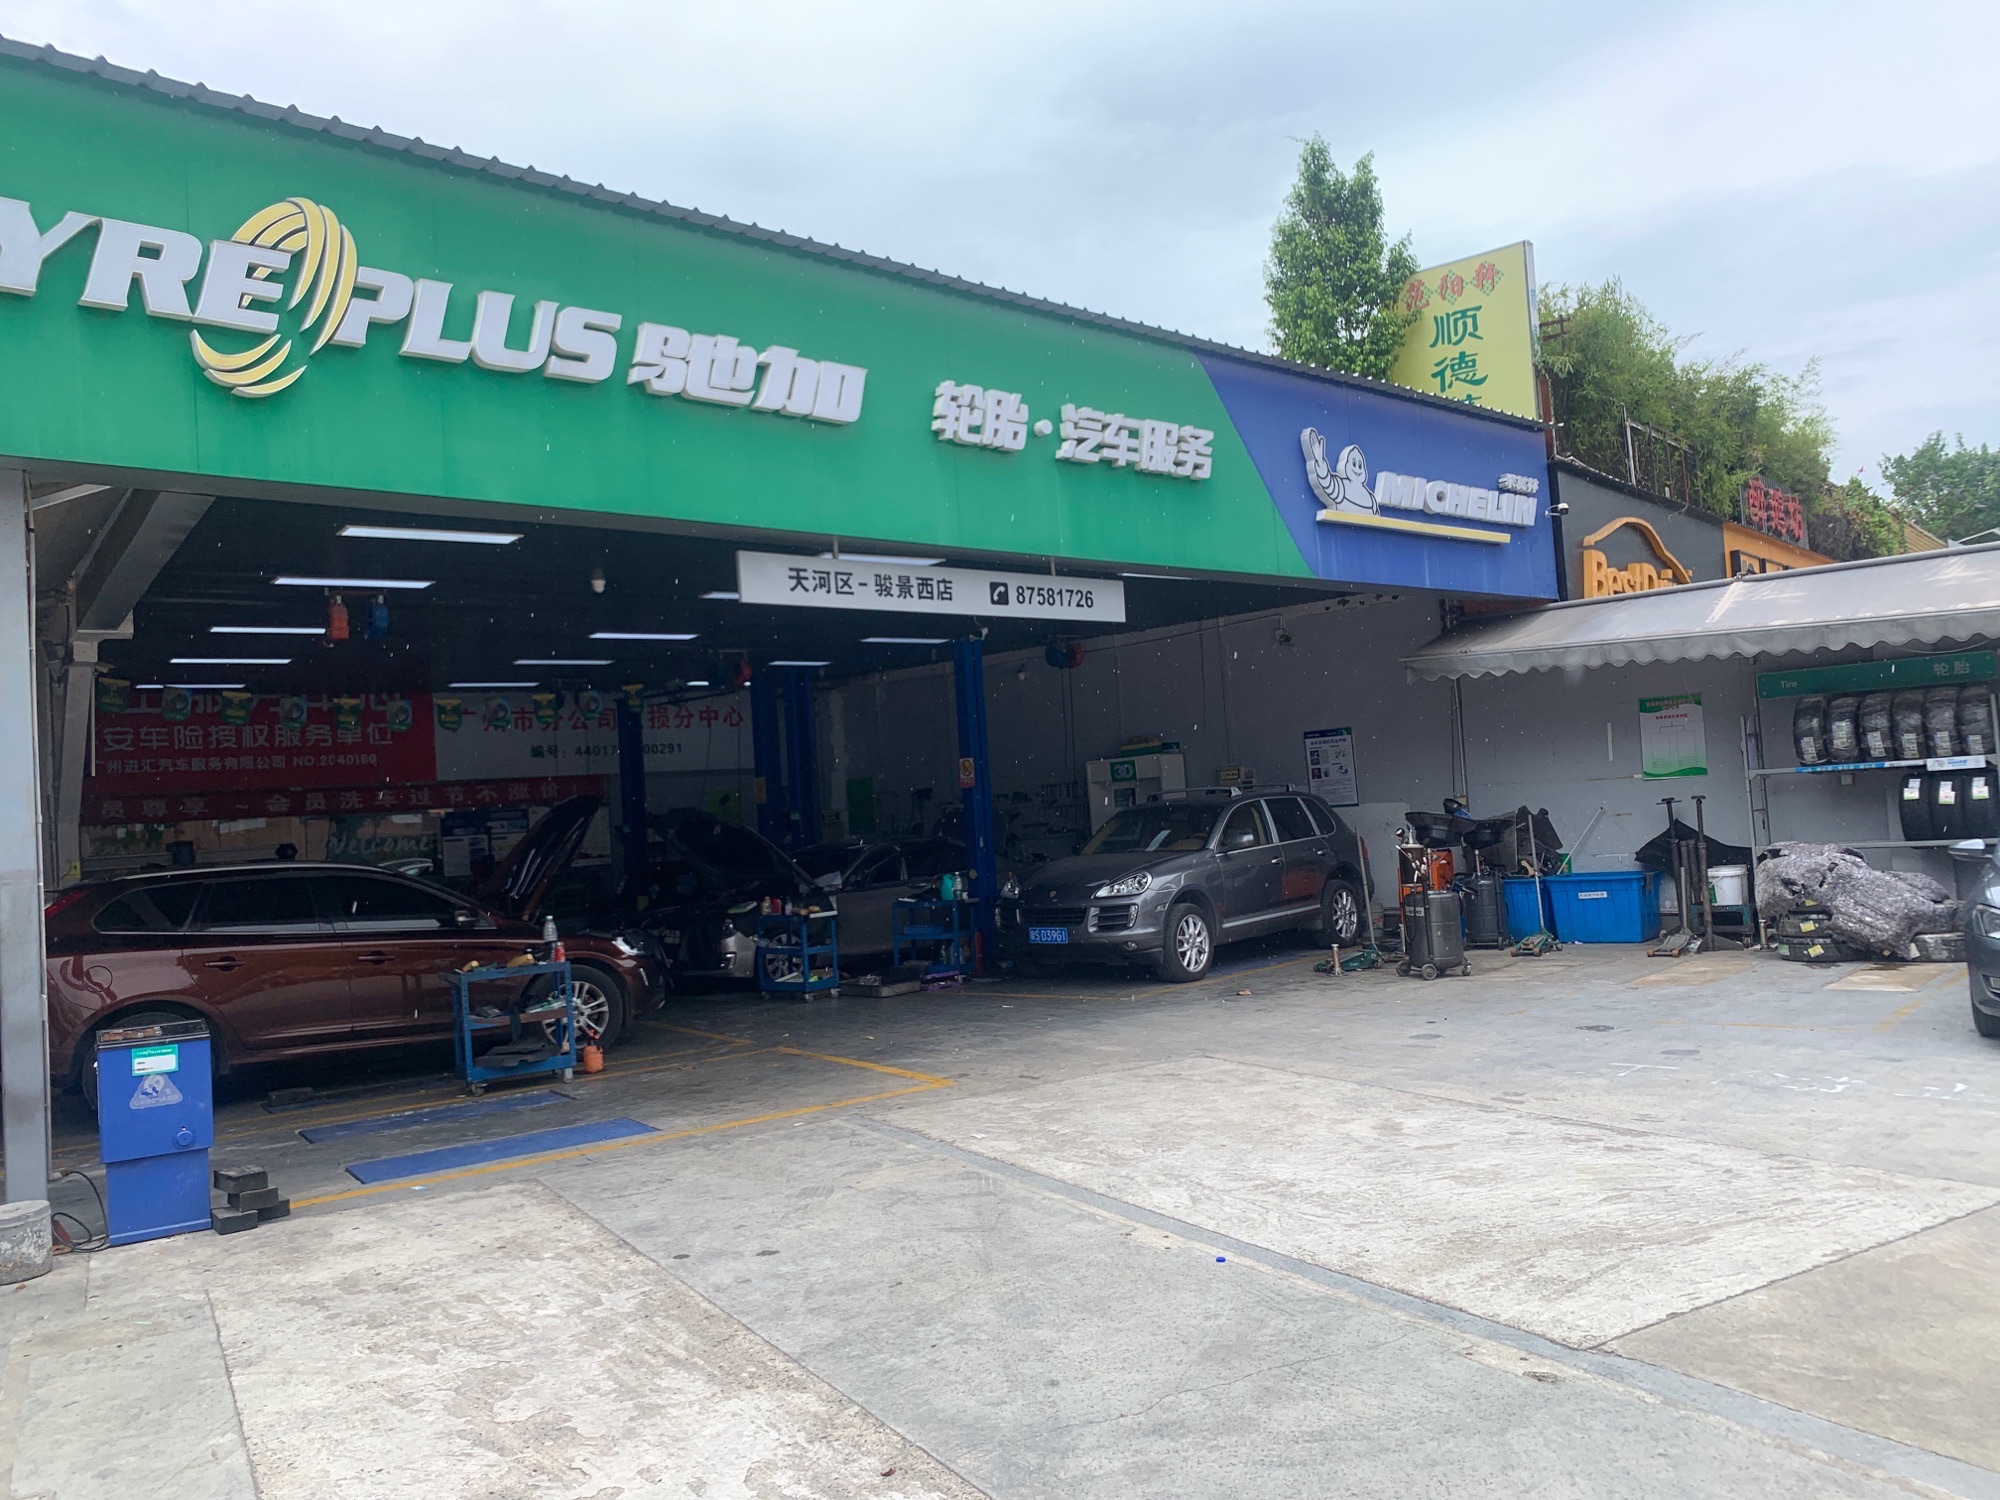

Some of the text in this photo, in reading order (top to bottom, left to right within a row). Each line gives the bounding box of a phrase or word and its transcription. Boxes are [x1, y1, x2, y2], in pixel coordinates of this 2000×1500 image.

[627, 321, 868, 425] 驰加
[1374, 471, 1538, 527] MICHELIN
[1015, 585, 1094, 608] 87581726
[1932, 660, 1971, 677] 轮胎
[1781, 680, 1798, 689] Tire
